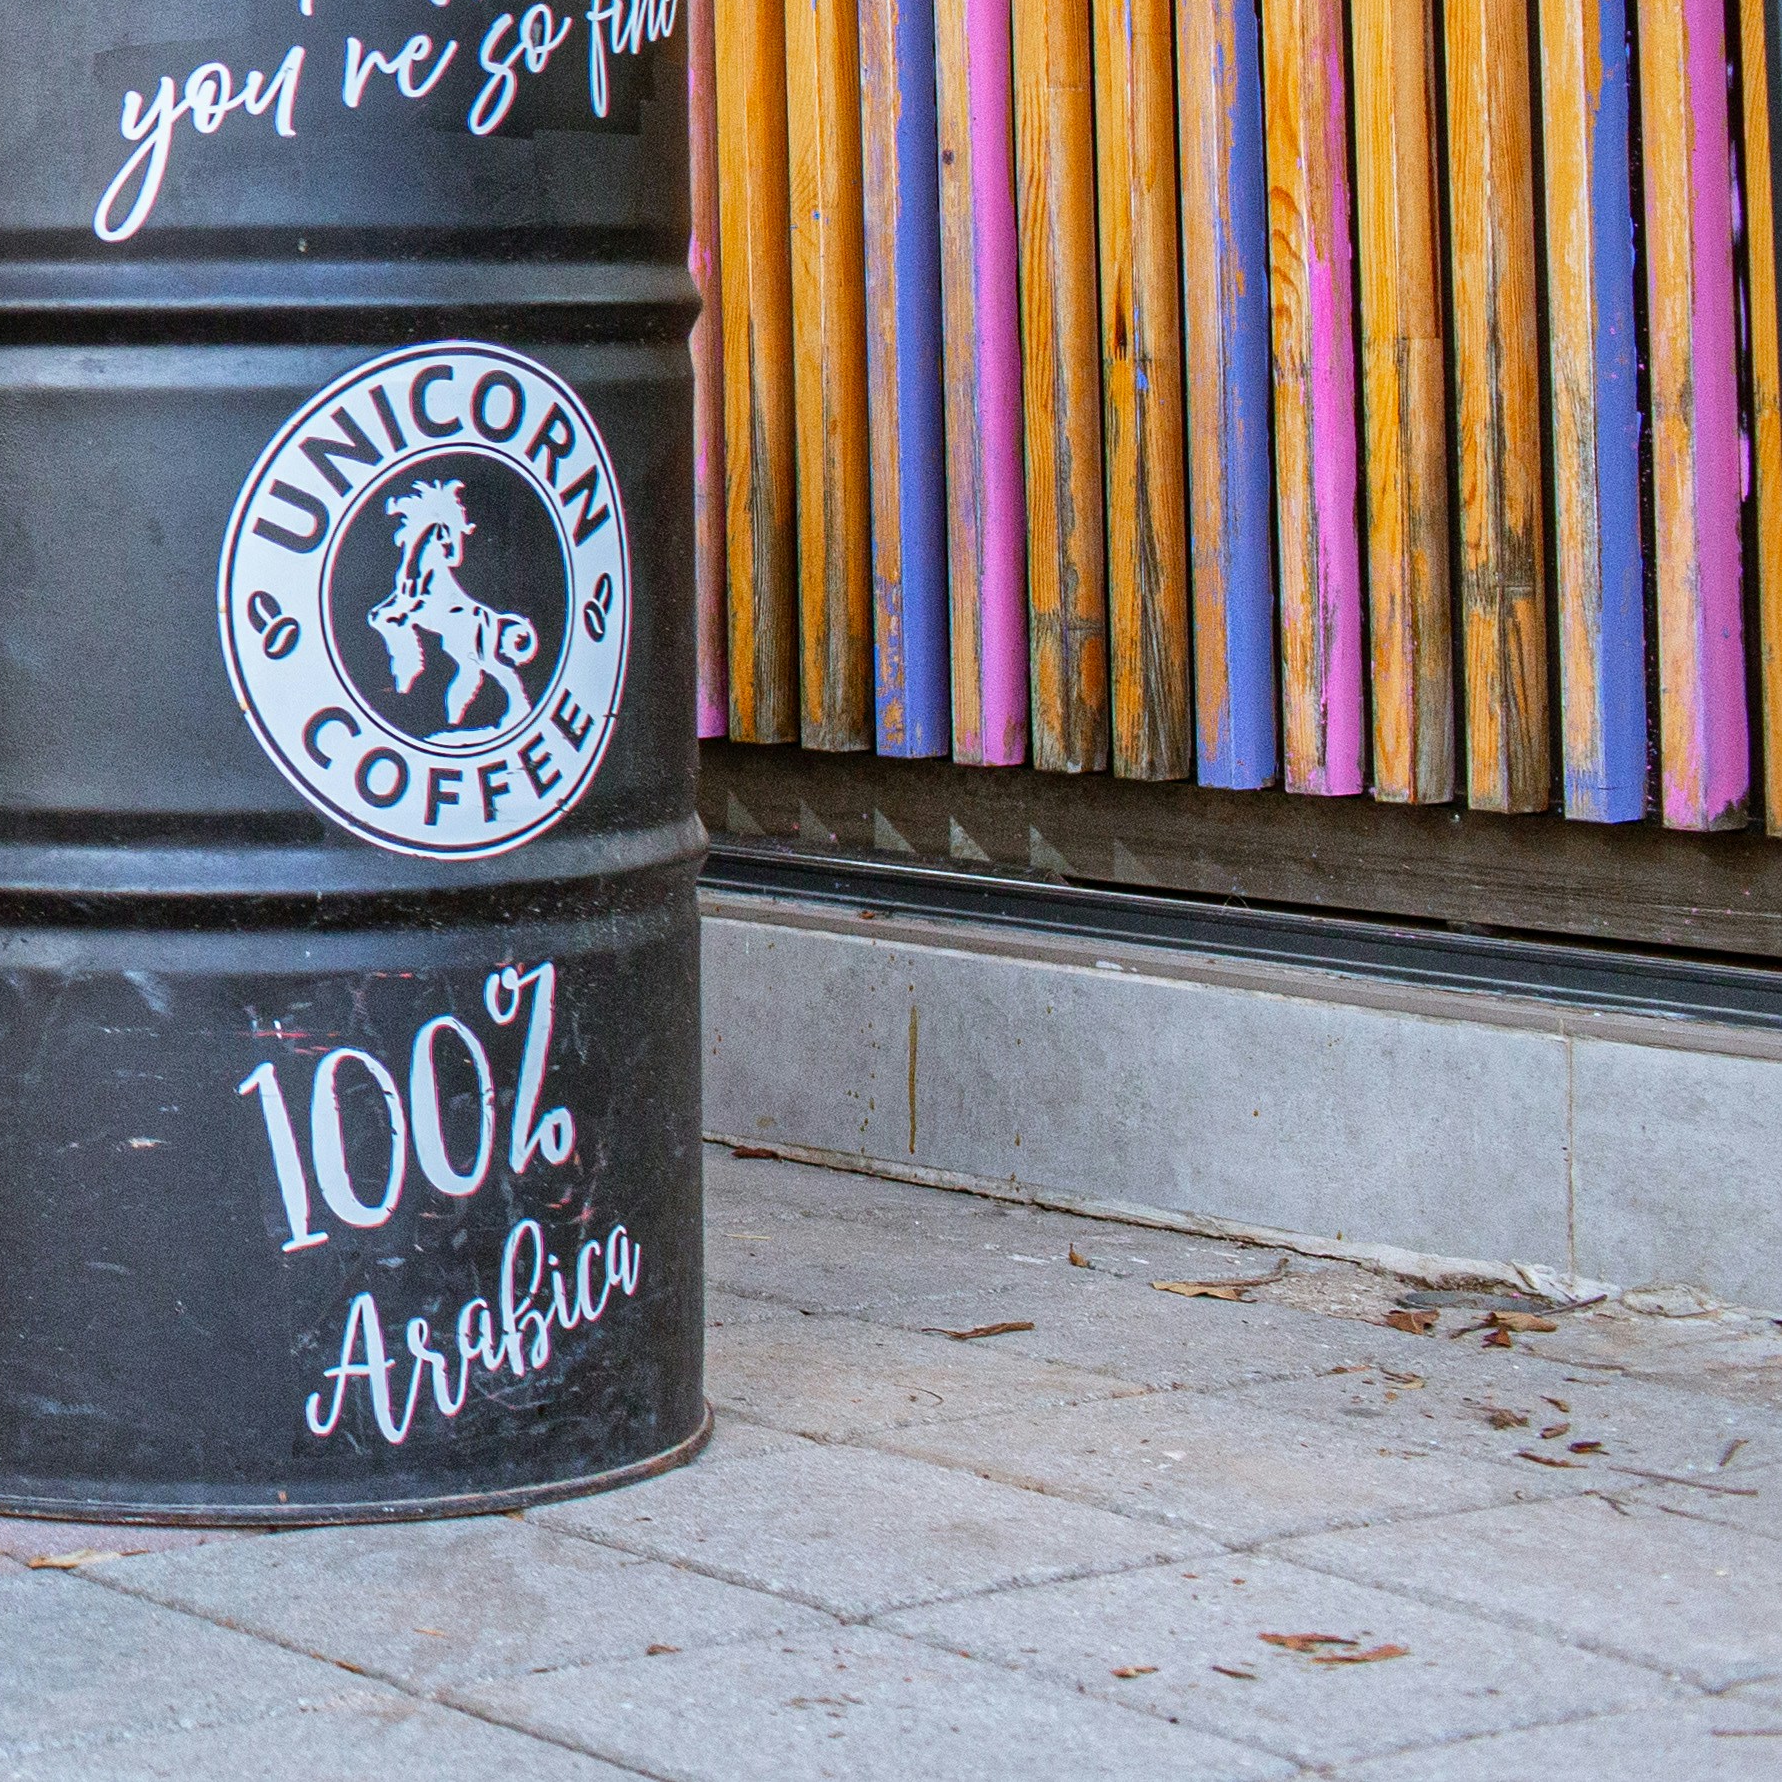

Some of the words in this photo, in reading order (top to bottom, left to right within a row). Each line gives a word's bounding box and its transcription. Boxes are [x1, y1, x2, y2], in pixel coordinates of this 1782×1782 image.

[467, 3, 572, 135] so
[252, 364, 611, 554] UNICORN
[301, 689, 594, 826] COFFEE
[238, 961, 576, 1253] 100%
[306, 1218, 641, 1444] Arabica
